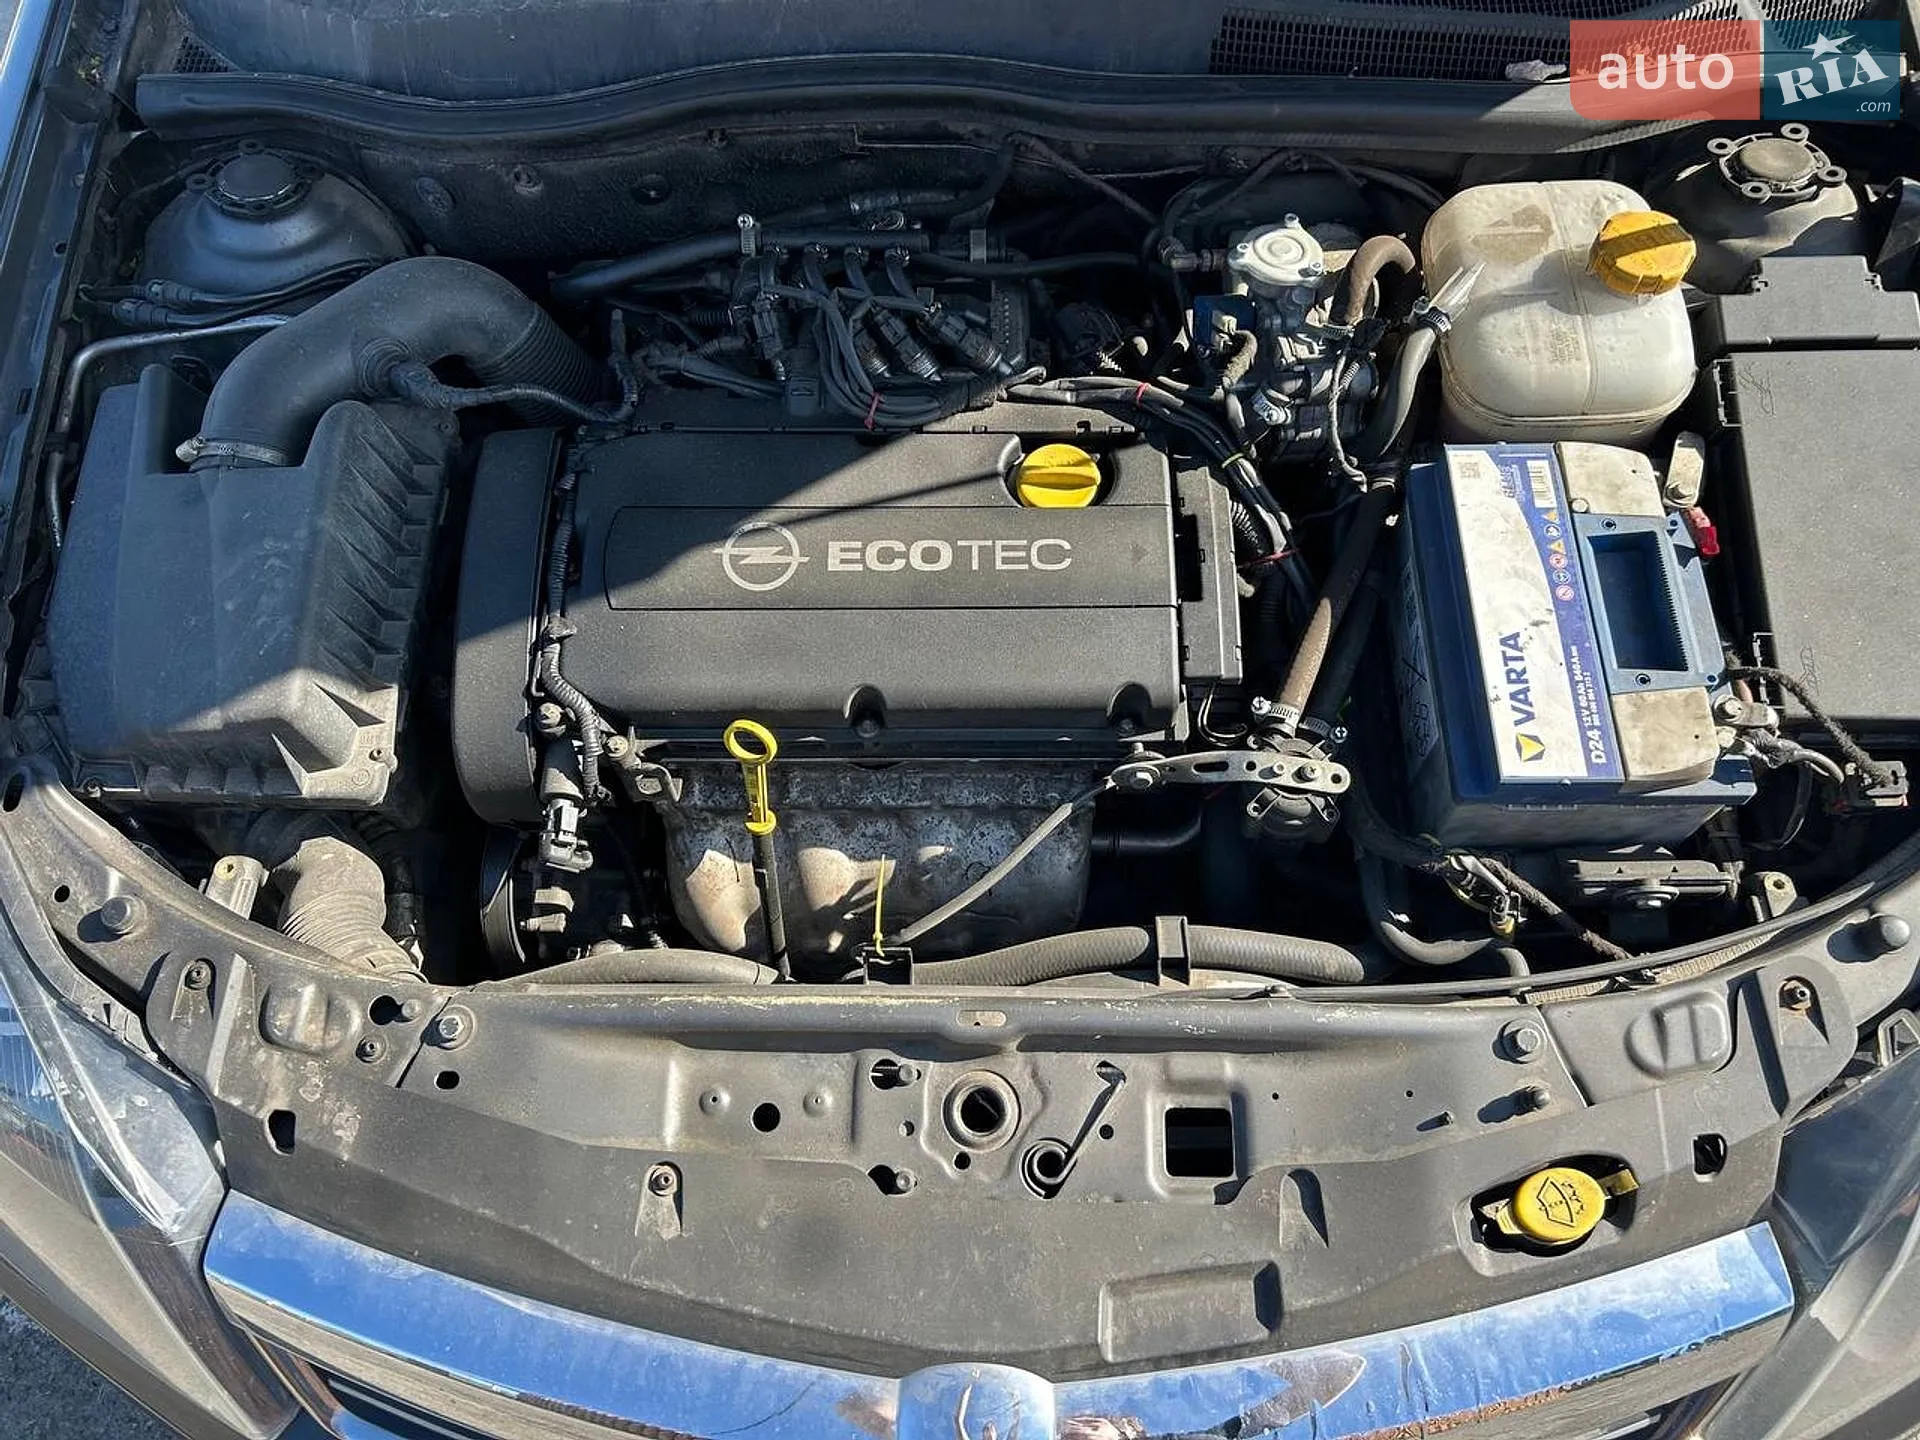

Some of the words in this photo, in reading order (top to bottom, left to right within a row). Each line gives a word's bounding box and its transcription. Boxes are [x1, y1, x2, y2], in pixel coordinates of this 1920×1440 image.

[827, 537, 1072, 571] ECOTEC
[1498, 631, 1537, 727] VARTA
[1586, 729, 1607, 765] D24
